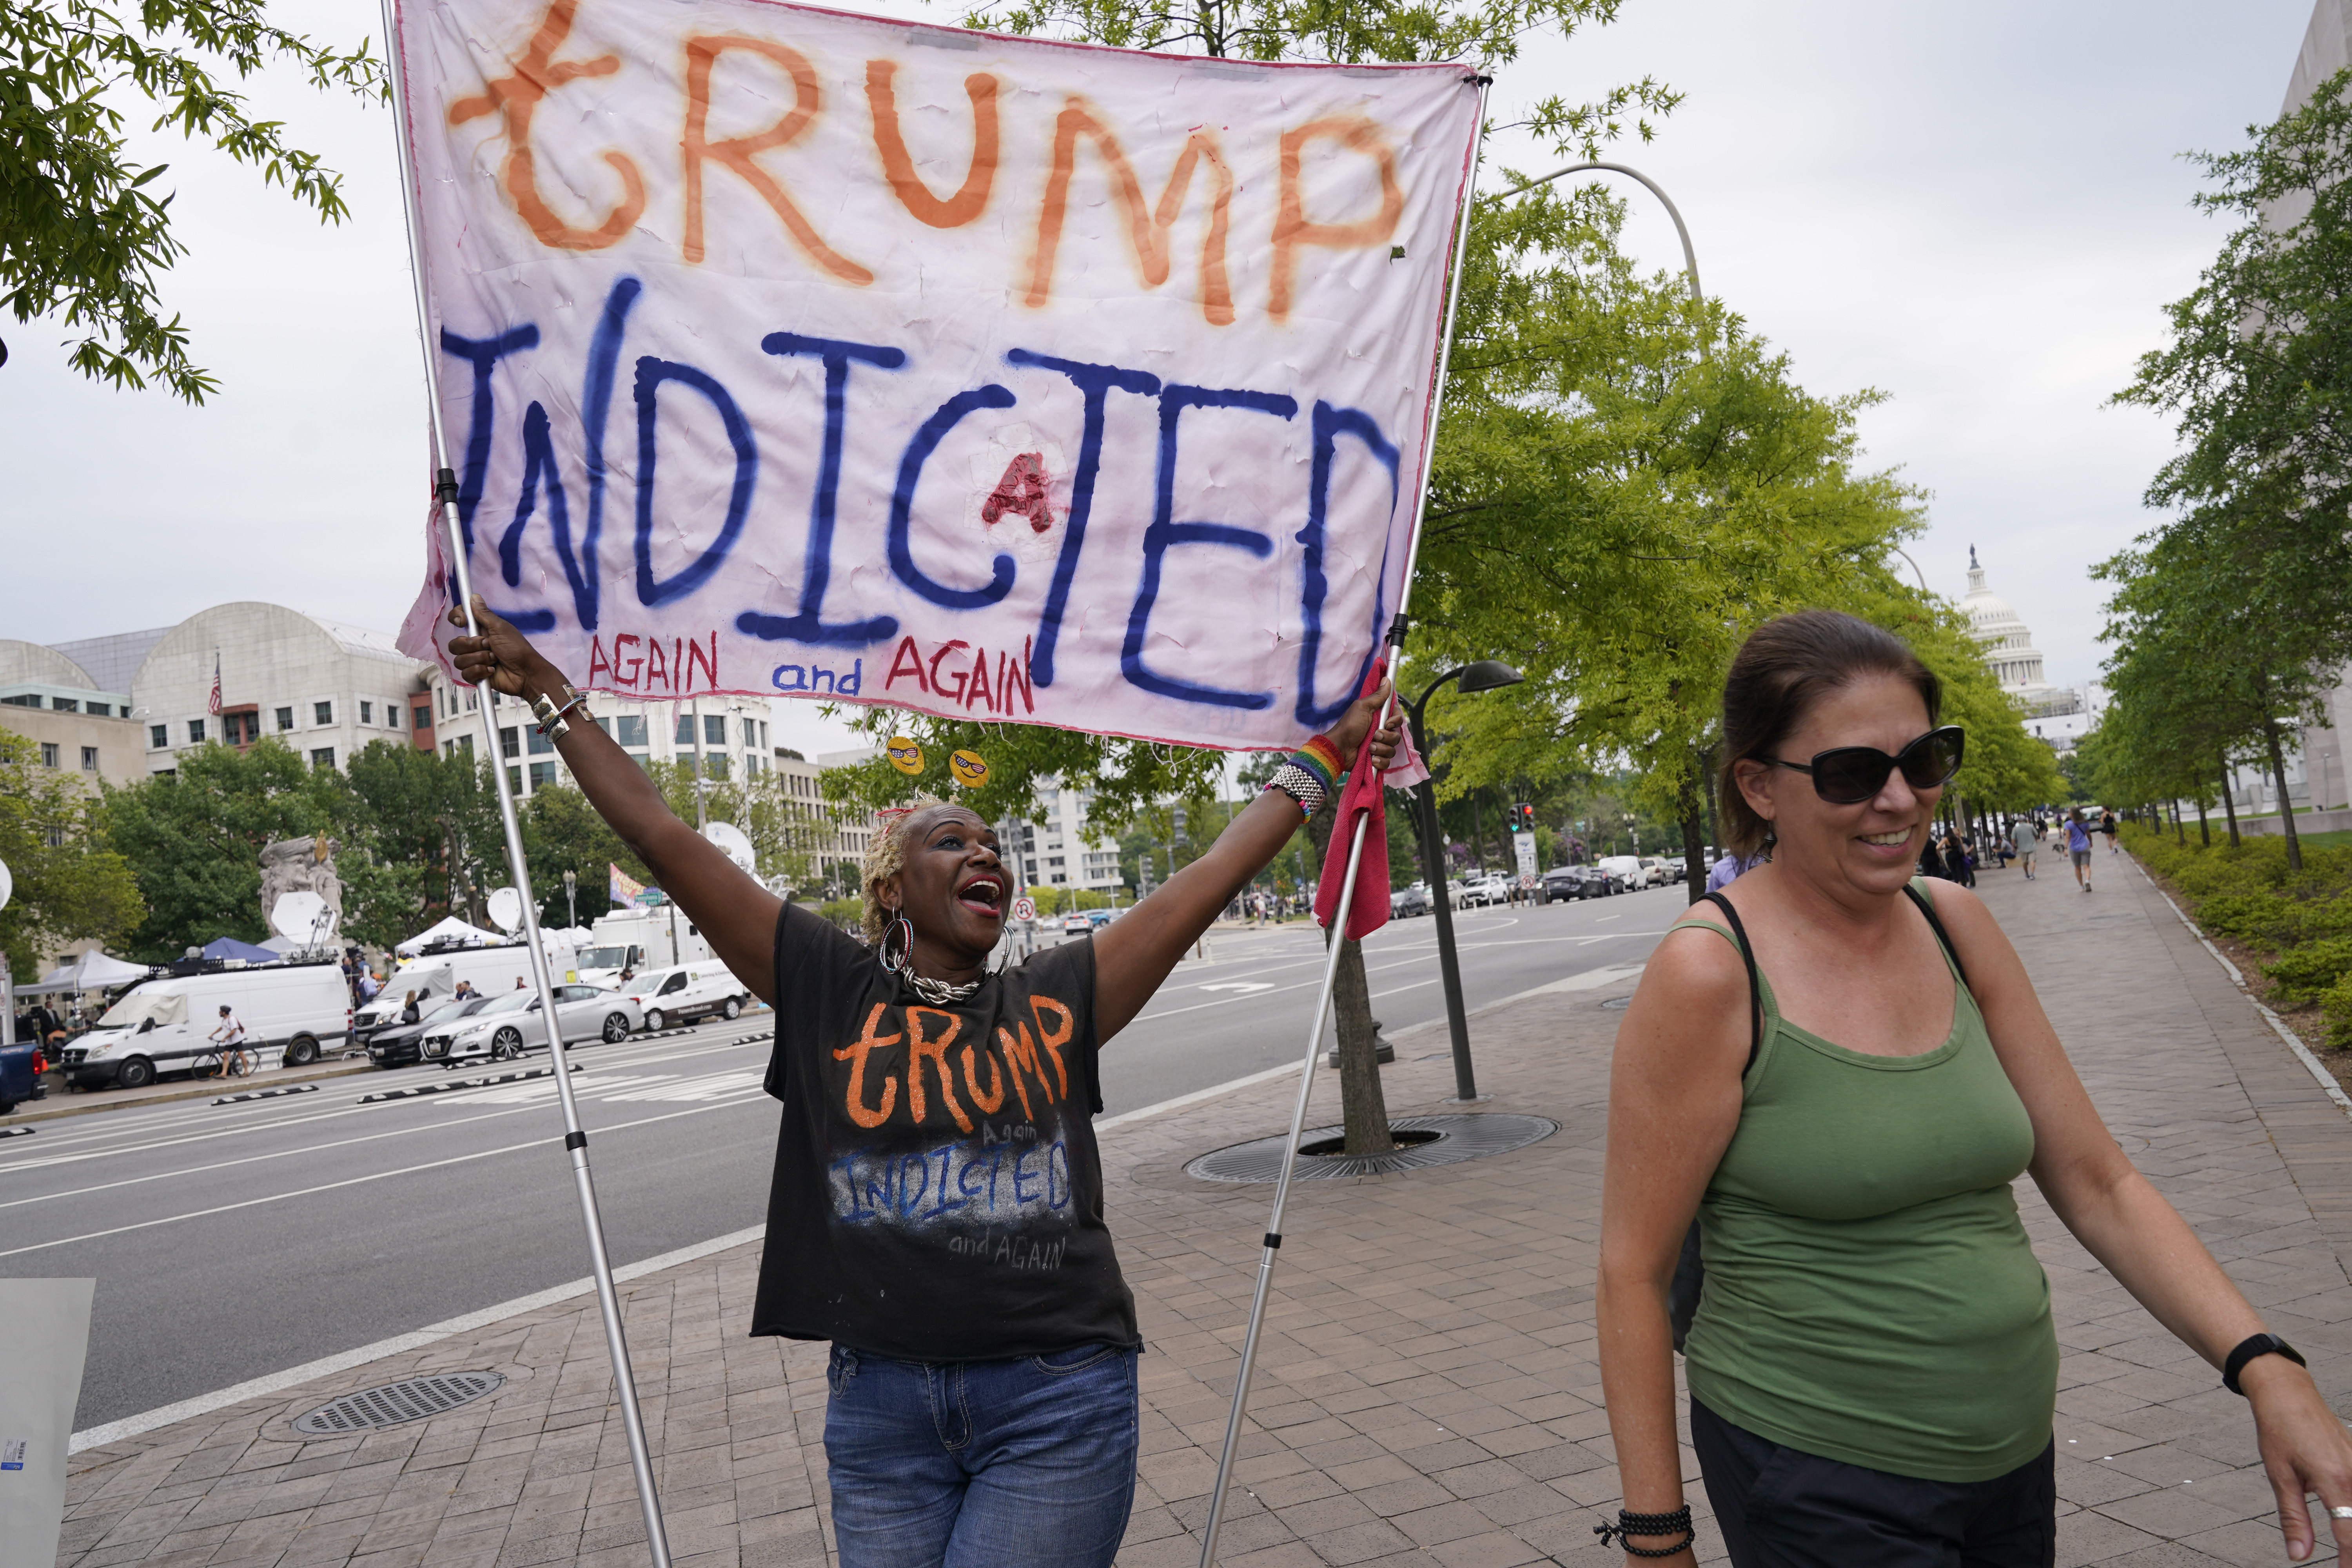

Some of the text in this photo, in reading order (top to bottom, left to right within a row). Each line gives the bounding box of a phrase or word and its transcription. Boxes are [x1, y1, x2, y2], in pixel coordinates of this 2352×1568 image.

[441, 277, 1400, 728] INDICTED
[982, 452, 1054, 533] A
[589, 630, 1035, 716] AGAIN and AGAIN
[983, 1120, 1036, 1146] Again
[831, 1140, 1072, 1223] INDICTED
[949, 1227, 1066, 1271] and AGAIN
